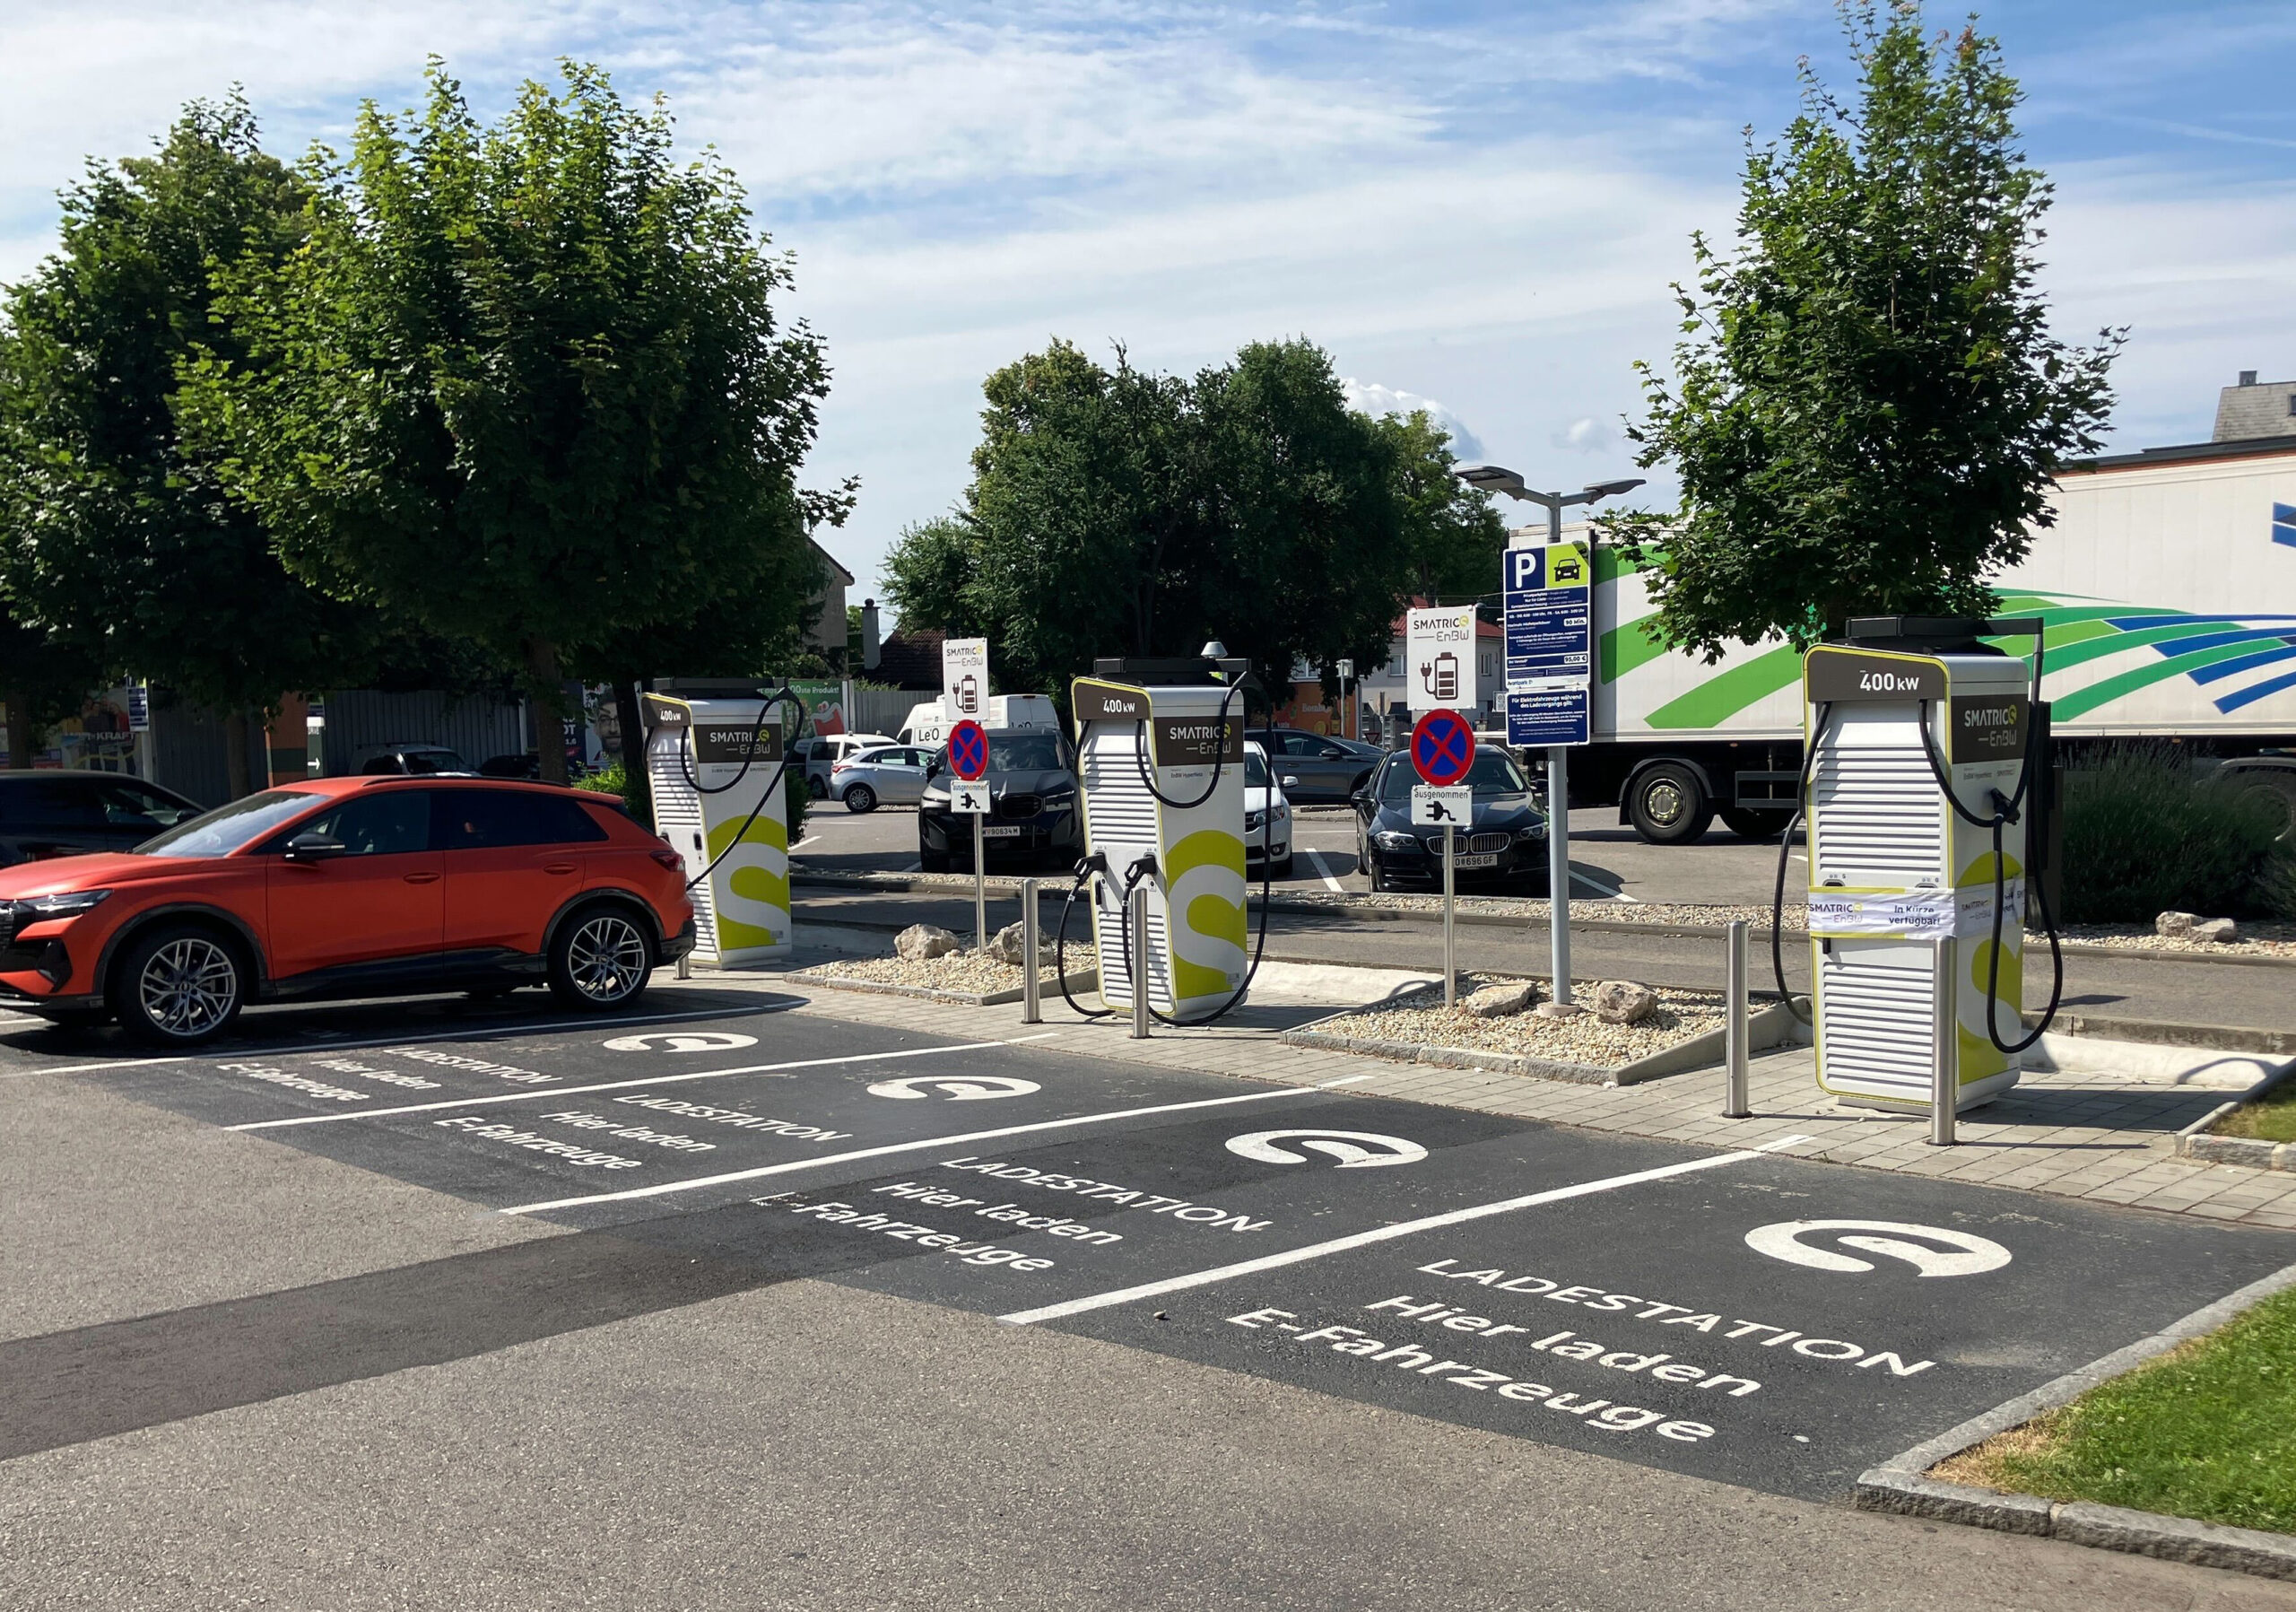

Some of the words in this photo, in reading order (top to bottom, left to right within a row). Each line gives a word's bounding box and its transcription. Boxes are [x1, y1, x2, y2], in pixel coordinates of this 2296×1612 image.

[1516, 553, 1535, 588] P
[1437, 630, 1469, 642] EnBW
[961, 658, 983, 666] EnBW
[1860, 673, 1894, 691] 400
[1898, 677, 1919, 691] kW
[660, 710, 673, 721] 400
[674, 712, 681, 720] kW
[1103, 700, 1122, 712] 400
[1123, 703, 1135, 712] kW
[1964, 704, 2016, 728] SMATRICS
[1989, 728, 2016, 746] EnBW
[1414, 791, 1468, 799] ausgenommen
[1834, 914, 1862, 923] EnBW
[1894, 905, 1903, 913] In
[216, 1062, 370, 1102] E-Fahrzeuge
[310, 1059, 376, 1076] Hier
[360, 1069, 442, 1090] laden
[383, 1047, 563, 1084] LADESTATION
[540, 1111, 622, 1130] Hier
[609, 1125, 718, 1153] laden
[613, 1094, 852, 1142] LADESTATION
[434, 1116, 642, 1169] E-Fahrzeuge
[939, 1157, 1274, 1232] LADESTATION
[872, 1182, 985, 1207] Hier
[975, 1203, 1123, 1245] laden
[1416, 1259, 1937, 1377] LADESTATION
[1365, 1295, 1529, 1336] Hier
[1530, 1330, 1761, 1398] laden
[1226, 1306, 1716, 1442] E-Fahrzeuge
